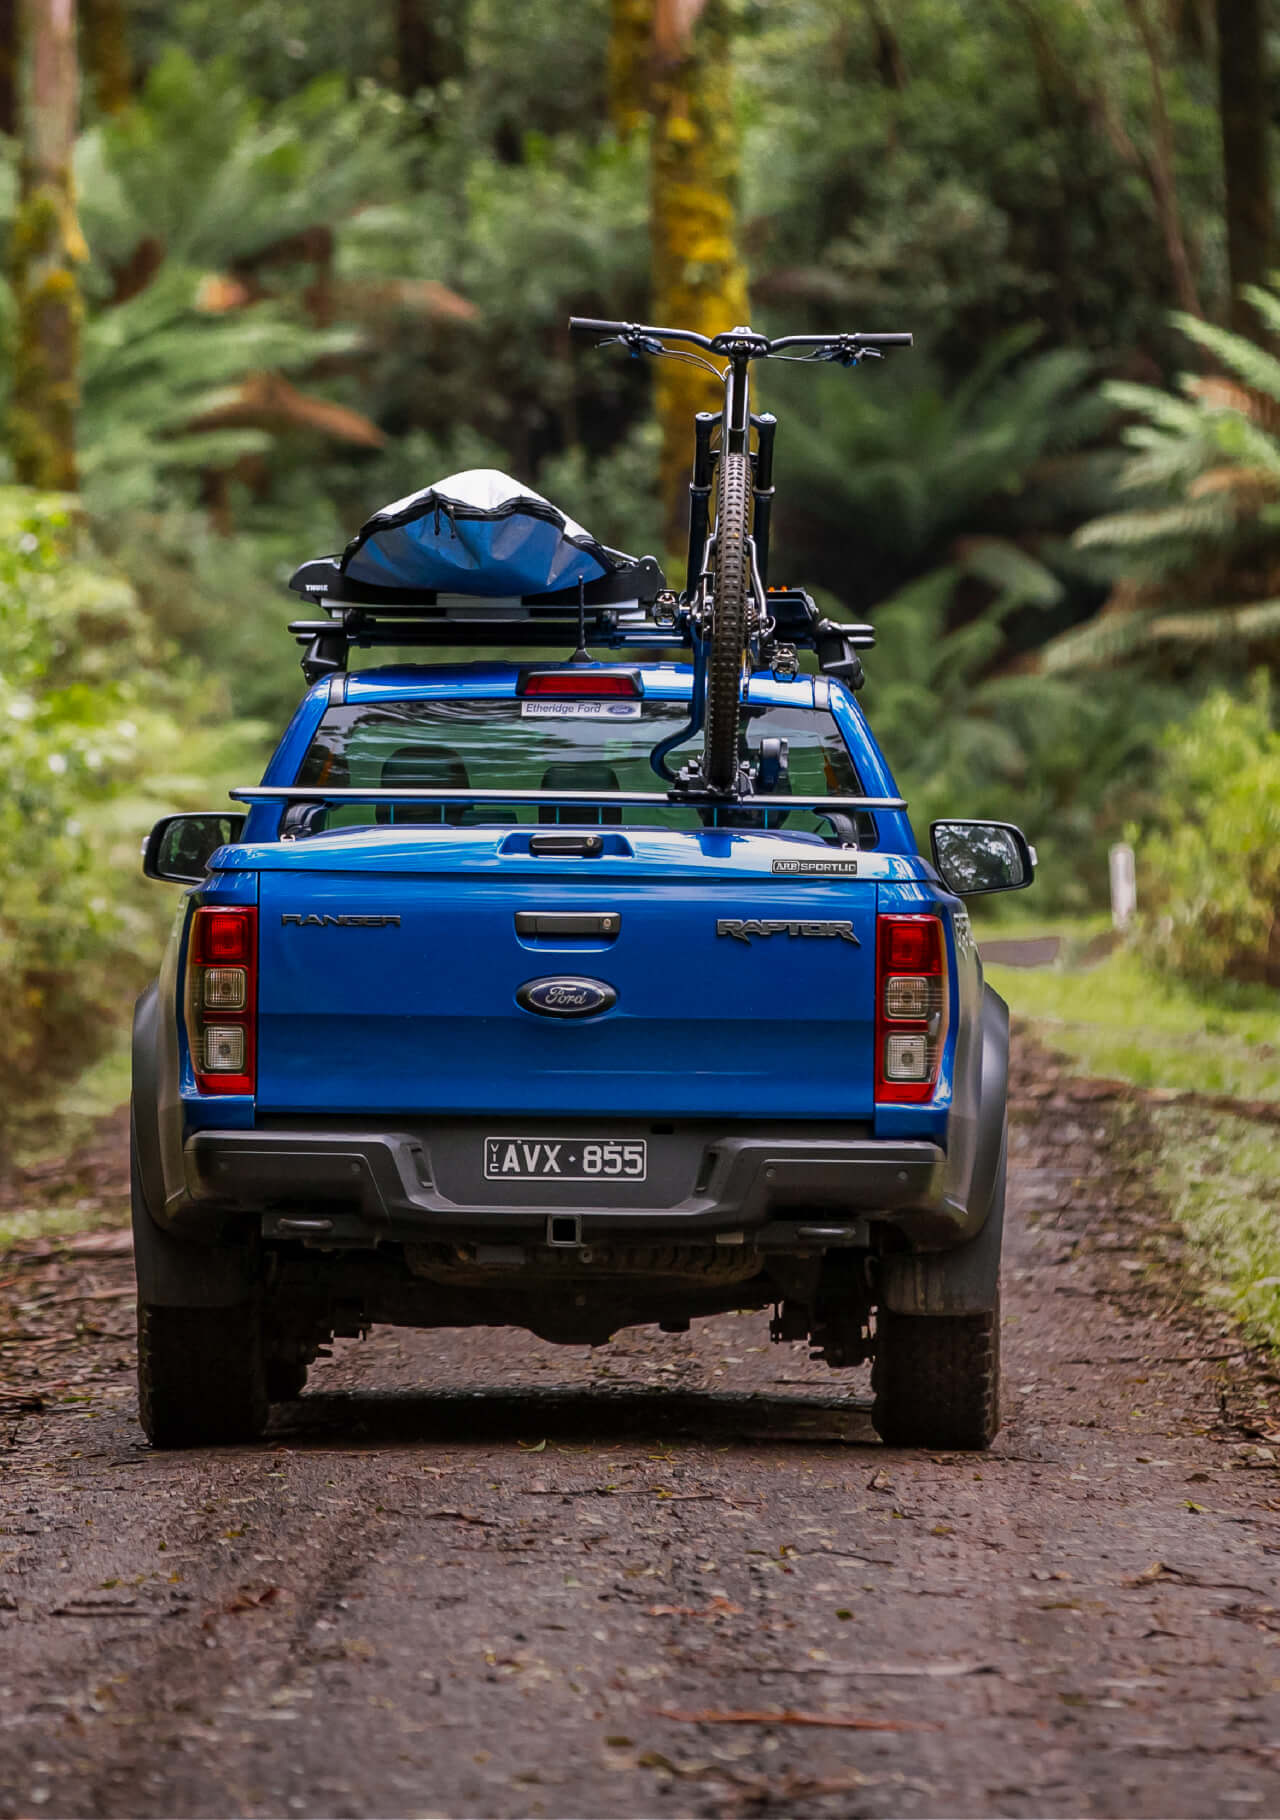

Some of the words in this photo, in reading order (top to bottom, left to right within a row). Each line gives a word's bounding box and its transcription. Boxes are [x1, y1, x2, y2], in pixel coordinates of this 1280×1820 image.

[526, 703, 574, 714] Etheridge
[578, 703, 601, 713] Ford
[776, 862, 797, 871] ARB
[800, 863, 856, 872] SPORTLID
[282, 914, 401, 927] RANGER
[716, 919, 861, 944] RAPTOR
[545, 986, 587, 1005] Ford
[489, 1143, 500, 1173] VIC
